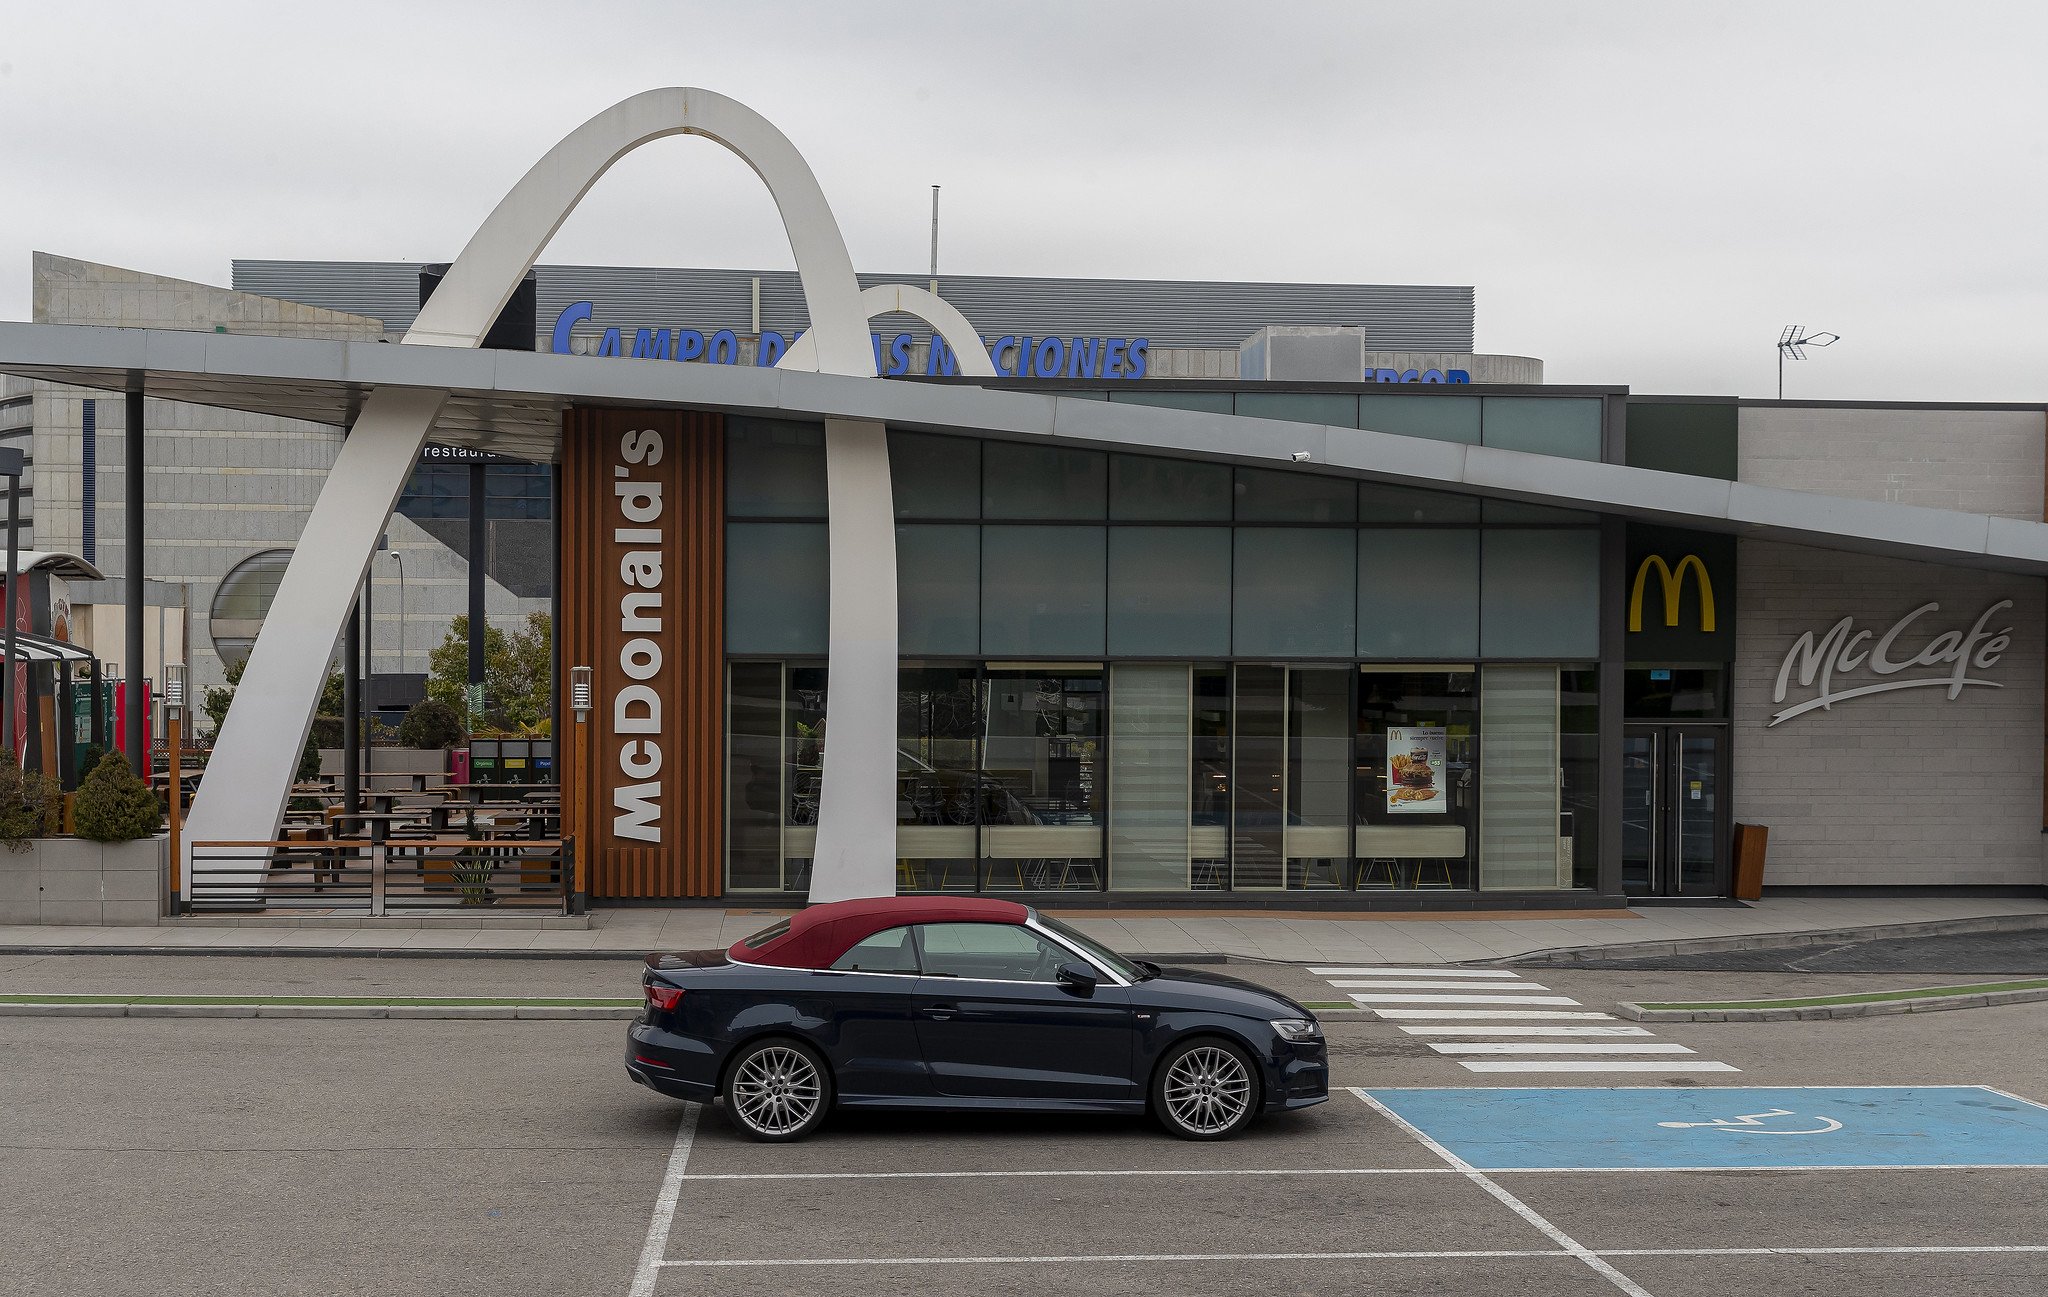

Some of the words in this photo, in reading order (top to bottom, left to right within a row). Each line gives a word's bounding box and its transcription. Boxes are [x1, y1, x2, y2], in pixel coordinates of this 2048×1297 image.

[927, 334, 1150, 379] NCIONES
[613, 428, 664, 843] McDonald's
[1771, 598, 2014, 712] McCafé
